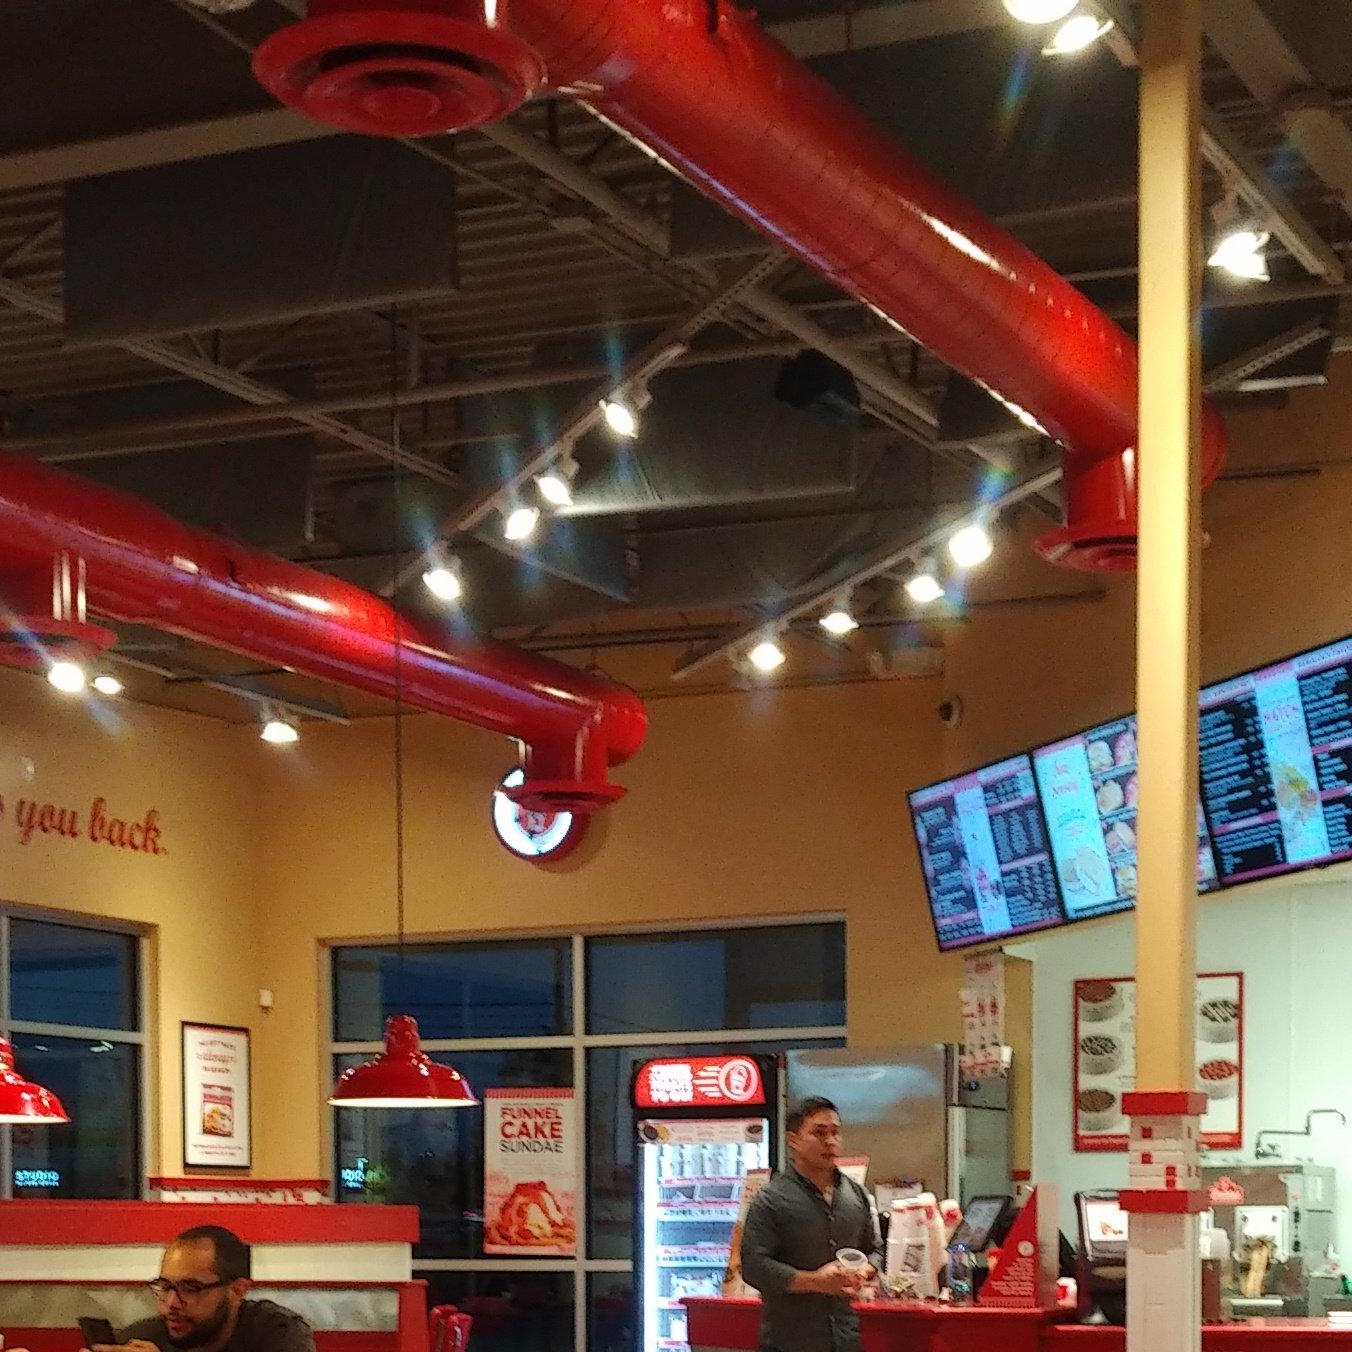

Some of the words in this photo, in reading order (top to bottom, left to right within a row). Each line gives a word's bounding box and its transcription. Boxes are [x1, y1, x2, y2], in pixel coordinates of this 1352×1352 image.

[15, 799, 78, 845] you
[500, 1107, 563, 1119] FUNNEL
[500, 1121, 563, 1139] CAKE
[499, 1140, 564, 1154] SUNDAE
